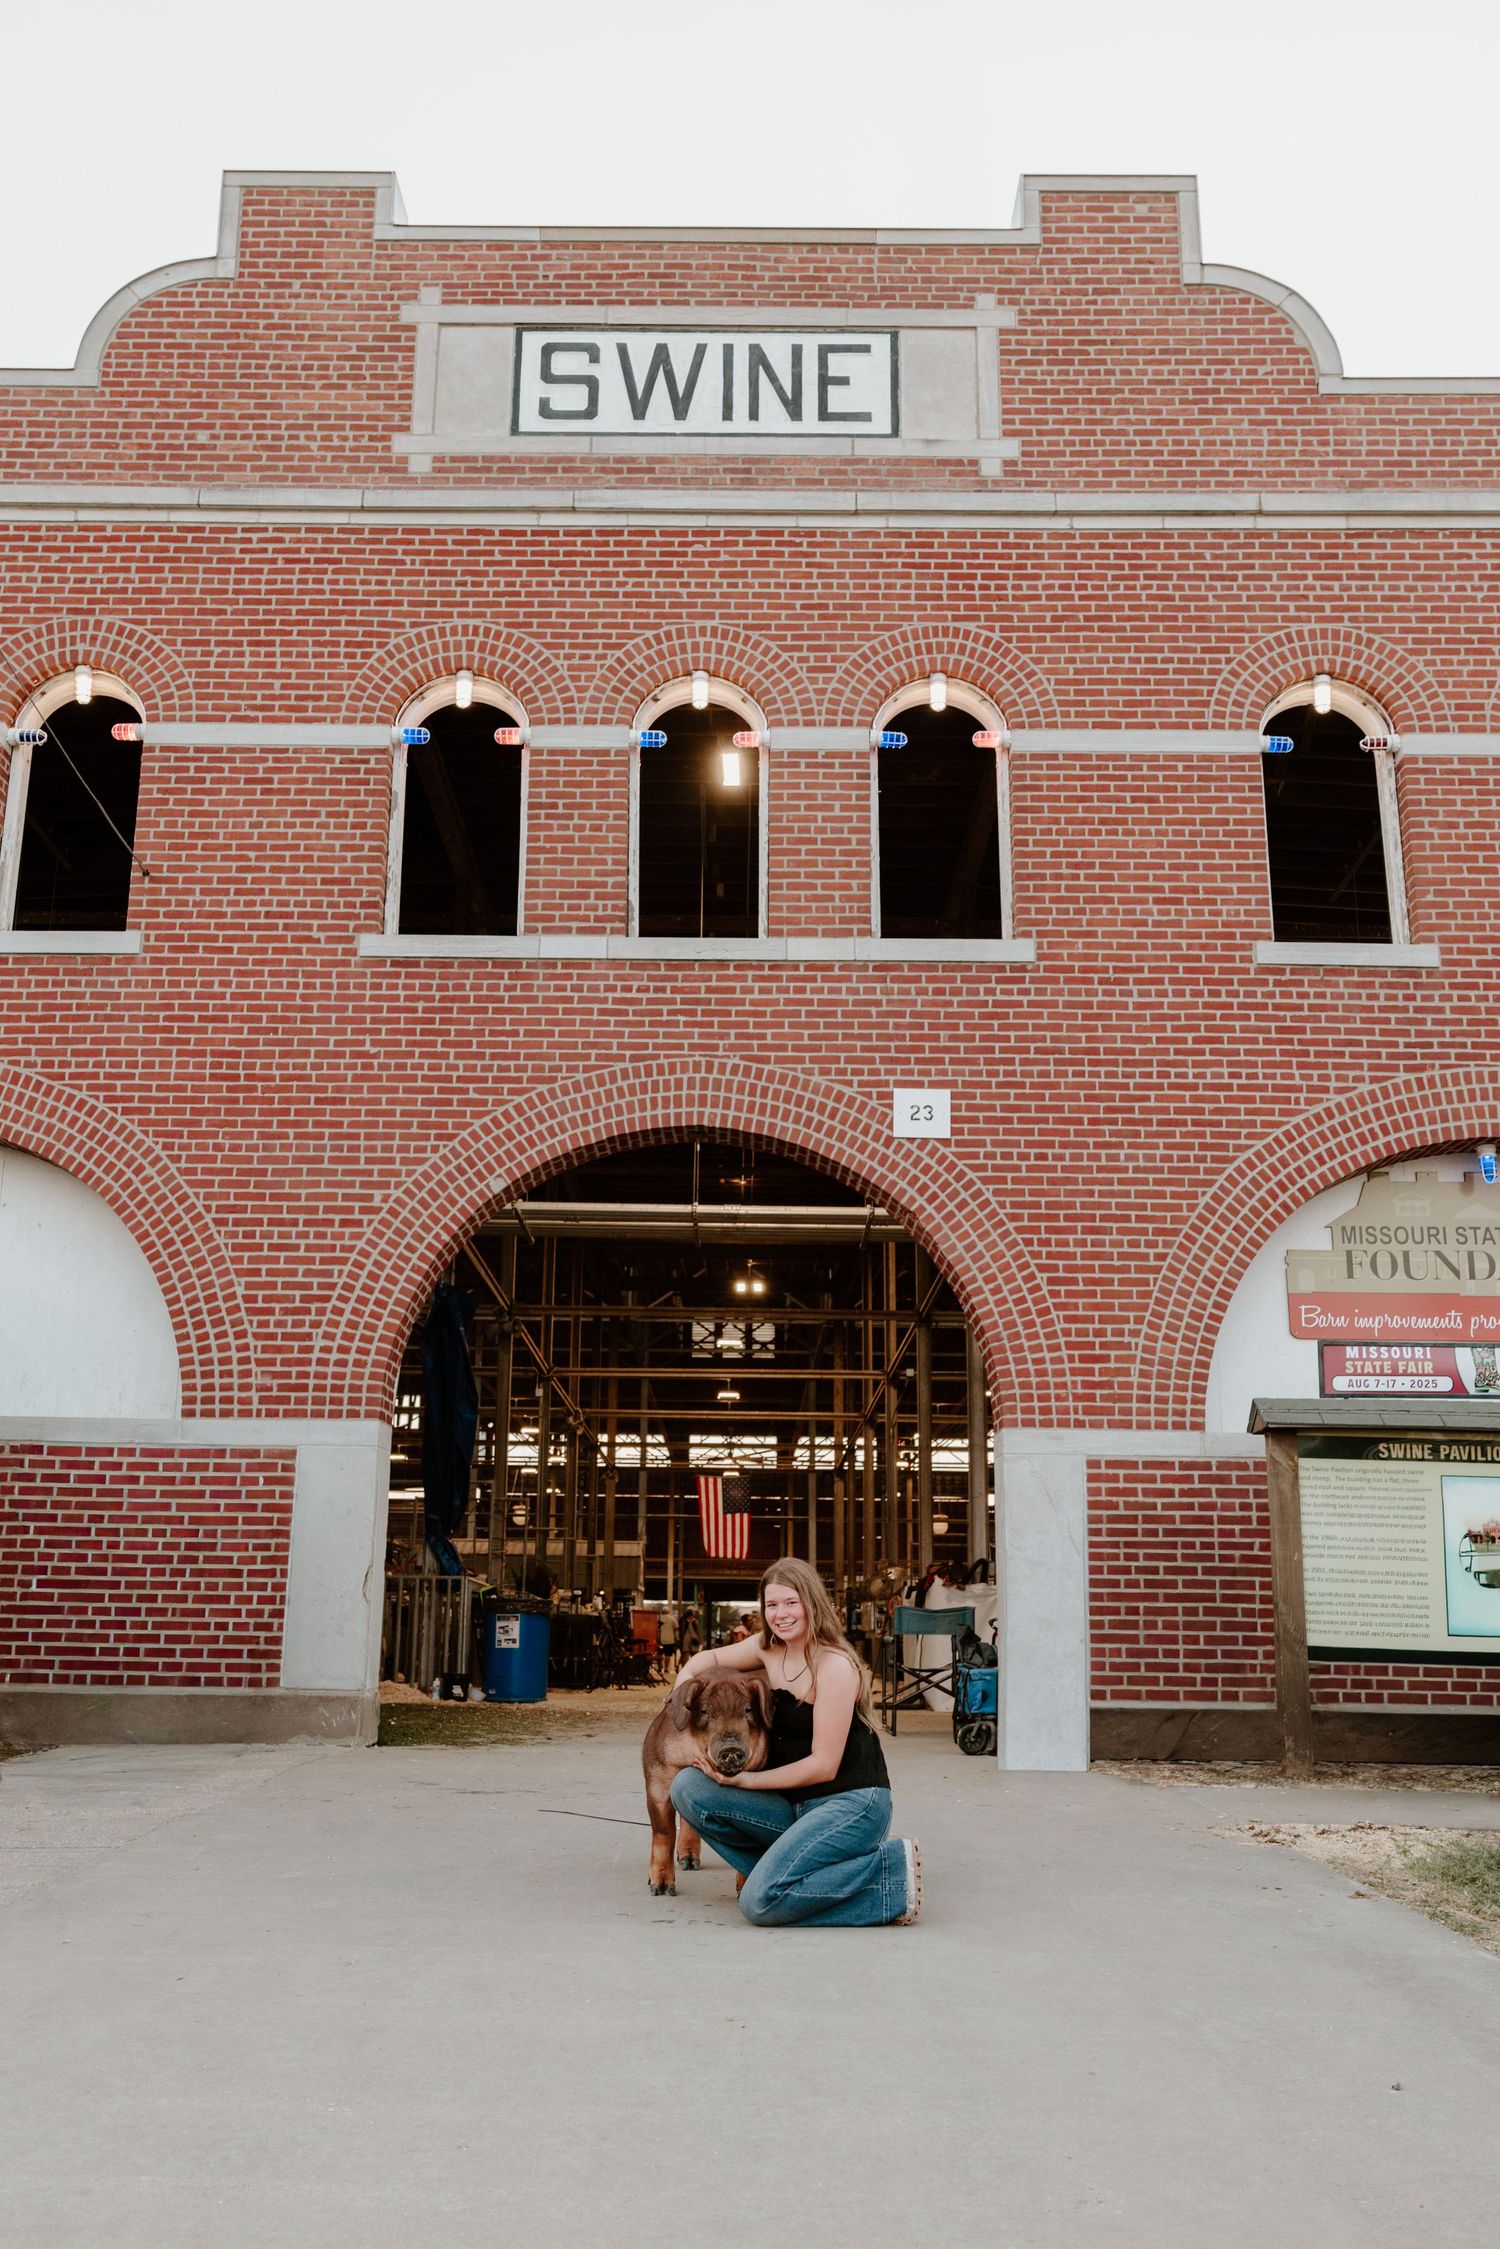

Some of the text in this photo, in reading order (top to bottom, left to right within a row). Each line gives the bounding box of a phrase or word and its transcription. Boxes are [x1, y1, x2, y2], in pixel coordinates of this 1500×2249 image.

[538, 341, 873, 423] SWINE
[910, 1104, 934, 1121] 23
[1341, 1225, 1448, 1245] MISSOURI
[1343, 1249, 1500, 1281] FOUND
[1299, 1304, 1350, 1328] Barn
[1354, 1309, 1463, 1337] improvements
[1345, 1346, 1432, 1359] MISSOURI
[1345, 1361, 1434, 1374] STATE FAIR
[1347, 1378, 1438, 1389] AUG 7-17 2025
[1378, 1442, 1433, 1460] SWINE
